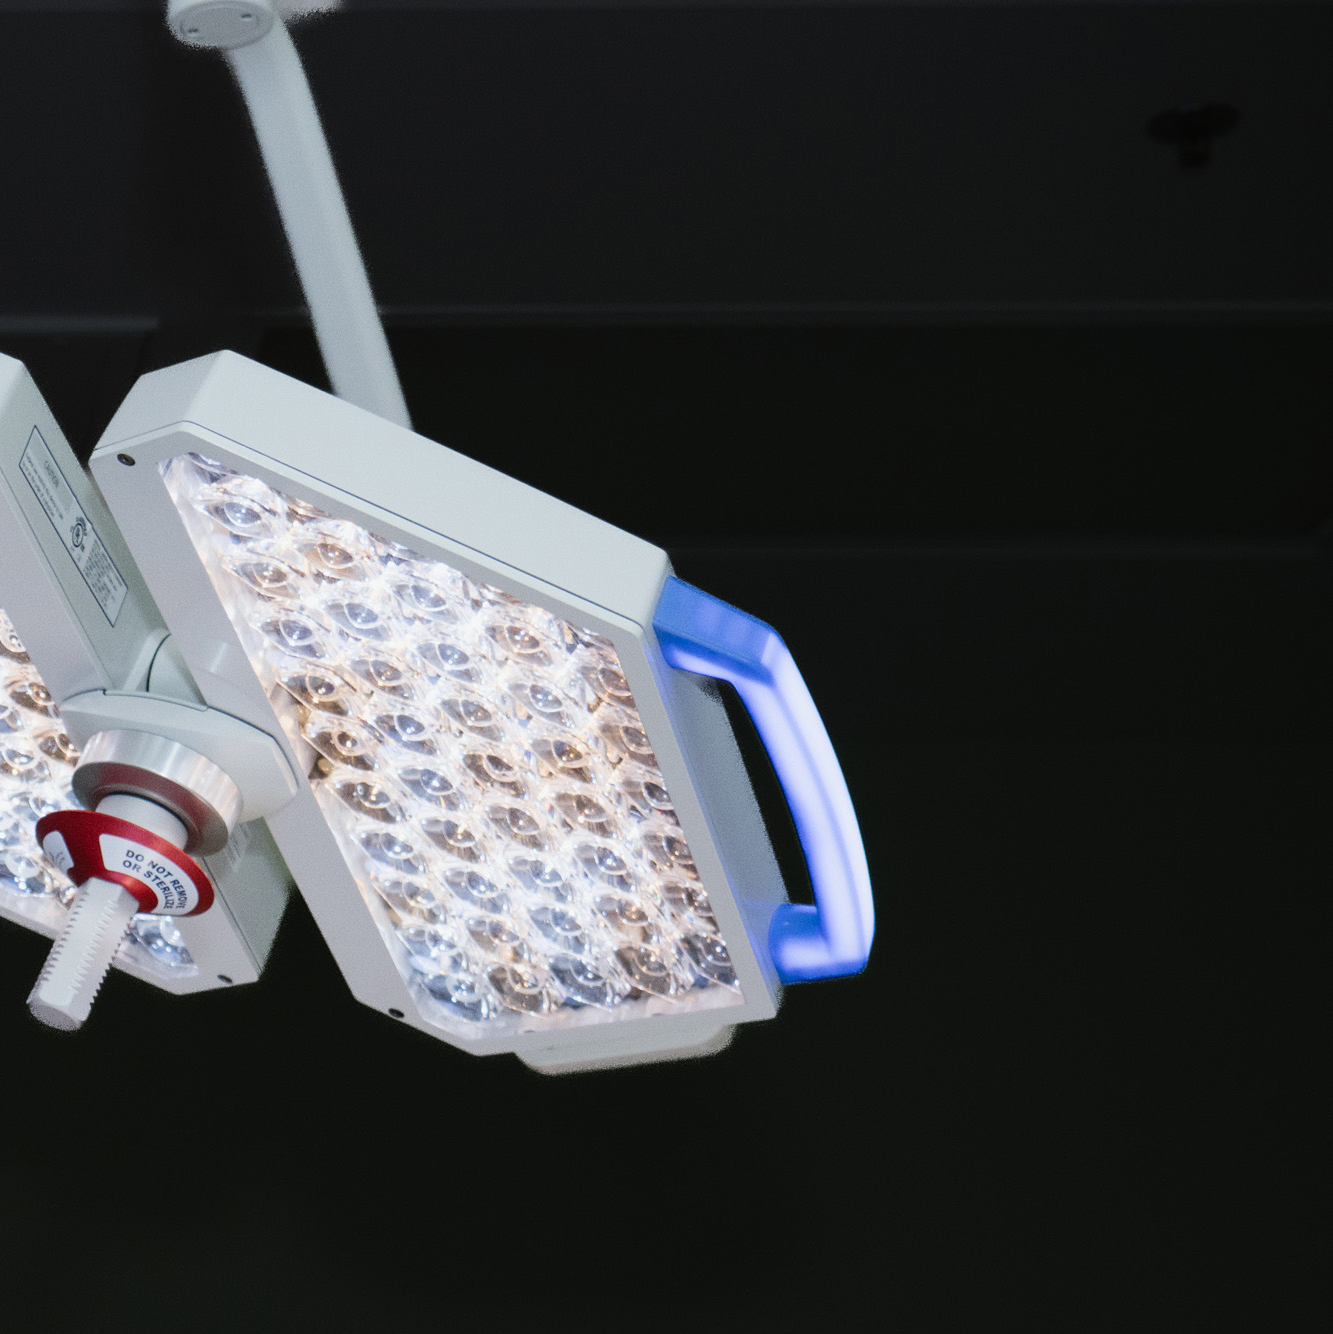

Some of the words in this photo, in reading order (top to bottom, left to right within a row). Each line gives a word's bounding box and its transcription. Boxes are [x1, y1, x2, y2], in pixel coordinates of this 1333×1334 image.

[122, 860, 141, 873] OR
[143, 870, 174, 910] STERILIZE
[125, 849, 144, 863] DO
[148, 860, 172, 880] NOT
[169, 878, 186, 910] REMOVE
